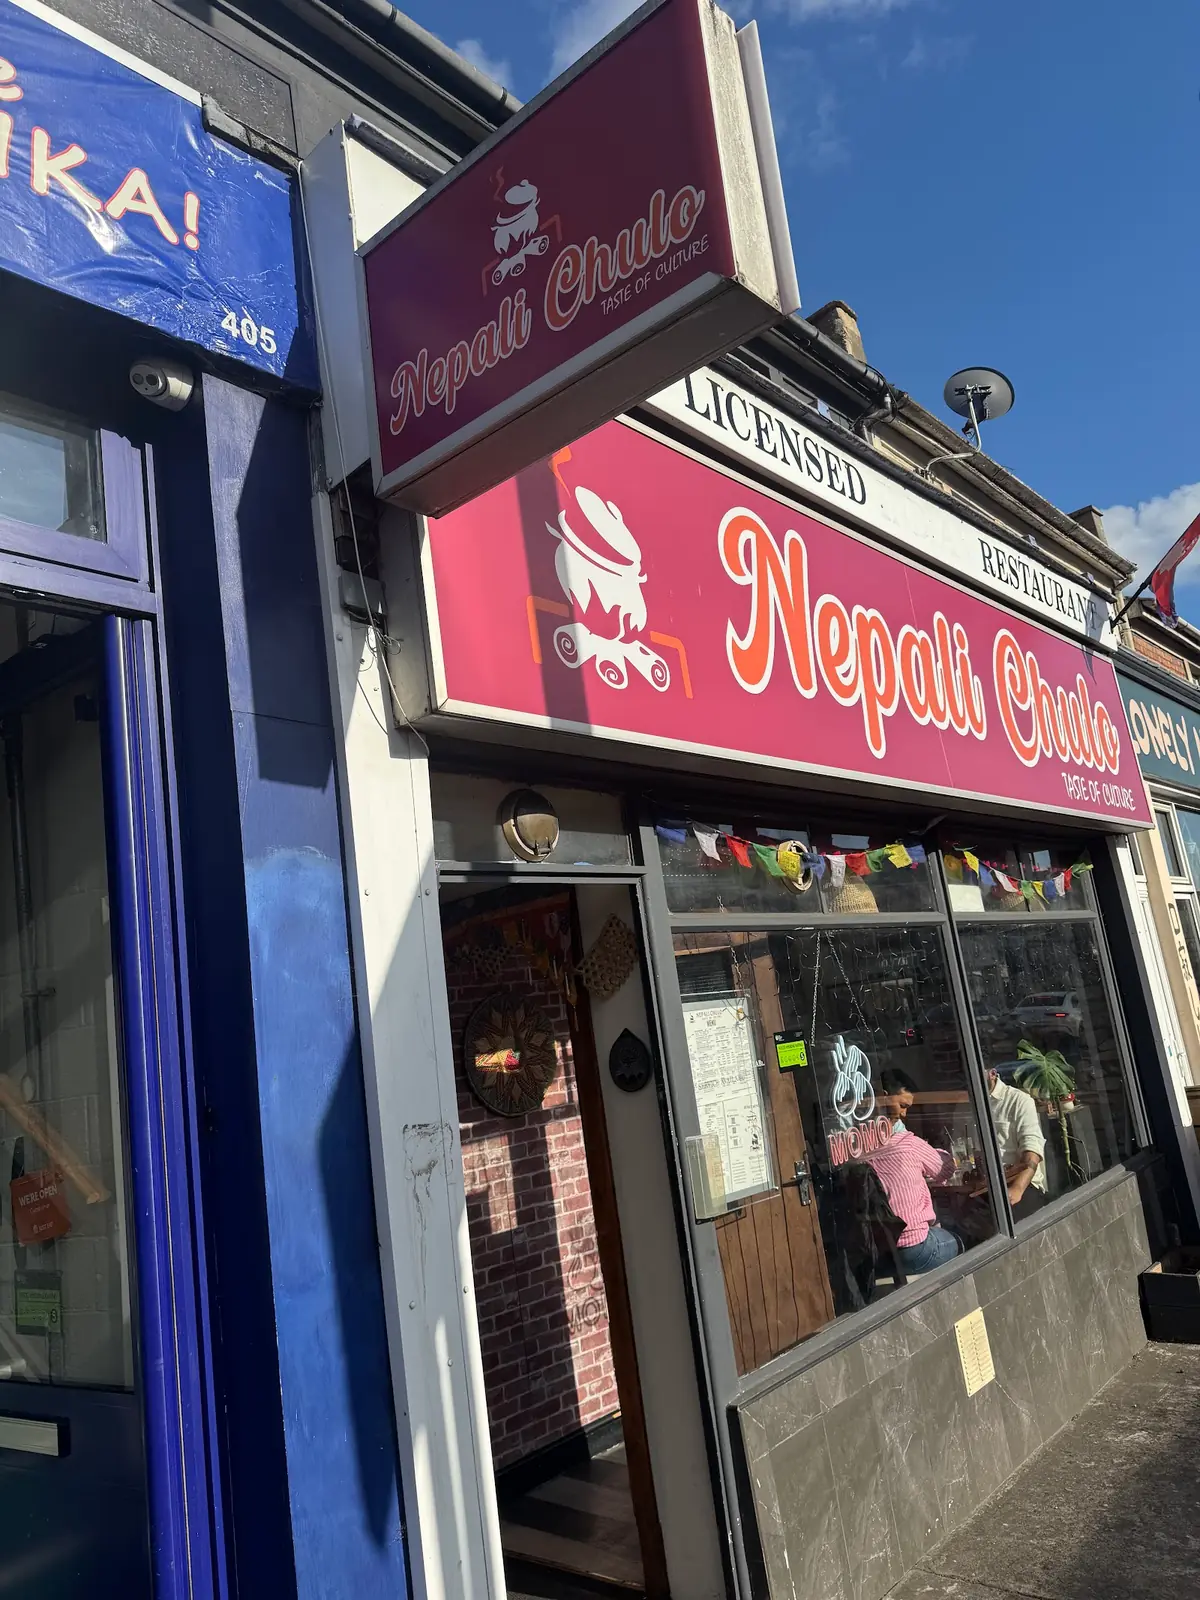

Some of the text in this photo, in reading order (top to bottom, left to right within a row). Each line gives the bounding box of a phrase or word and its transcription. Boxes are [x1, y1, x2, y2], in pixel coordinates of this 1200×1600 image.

[389, 184, 706, 436] Nepali Chulo
[600, 234, 710, 316] TASTE OF CULTURE
[220, 312, 277, 355] 405
[684, 373, 867, 506] LICENSED
[978, 537, 1099, 632] RESTAURANT
[717, 506, 1121, 776] Nepali Chulo
[1132, 698, 1196, 776] ONELY
[1061, 772, 1136, 812] TASTE OF CULTURE
[828, 1115, 891, 1166] MOMO
[39, 1184, 58, 1199] OPEN
